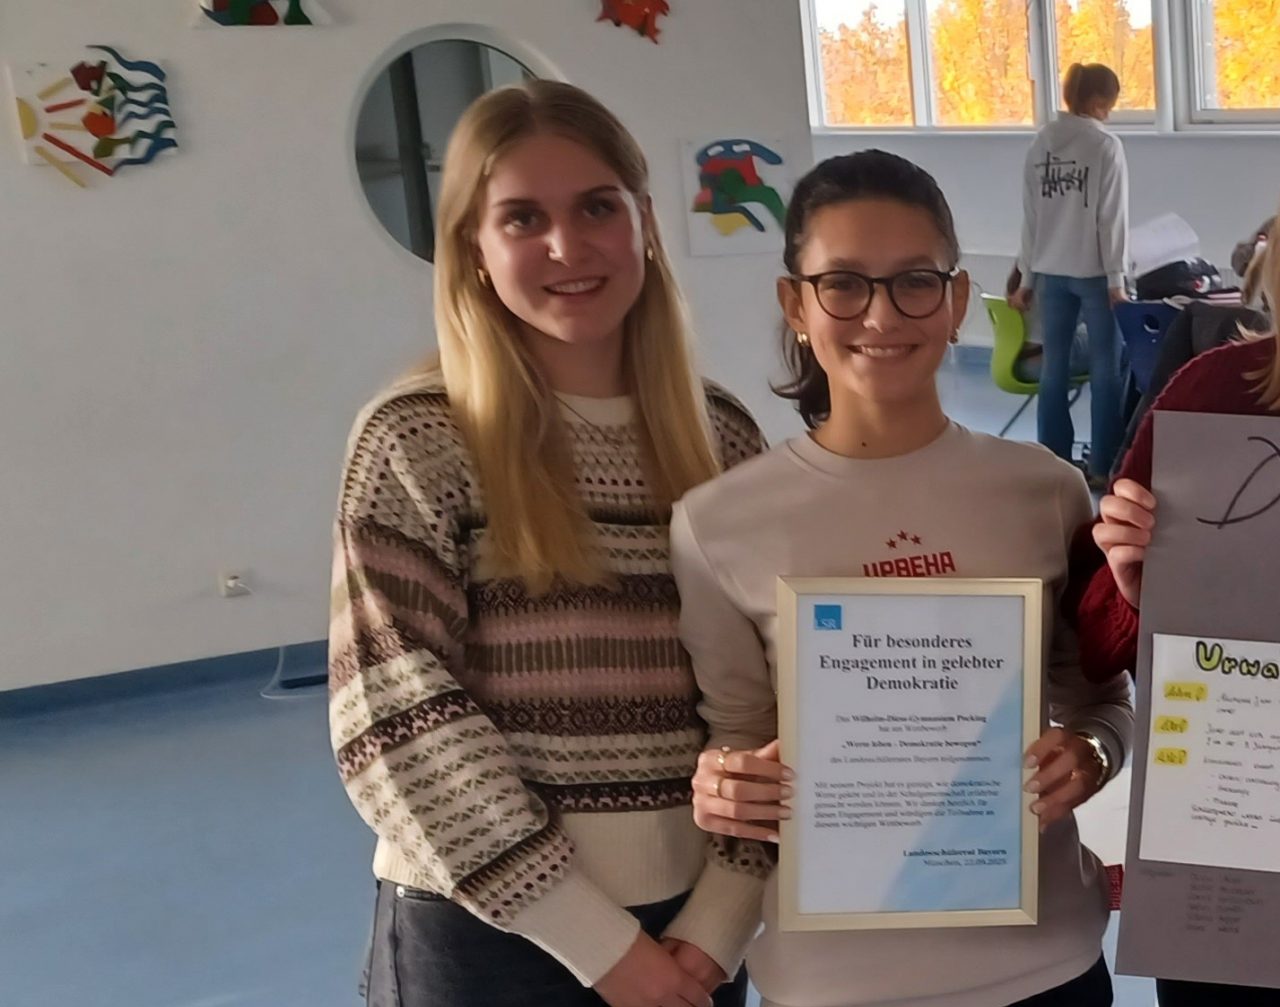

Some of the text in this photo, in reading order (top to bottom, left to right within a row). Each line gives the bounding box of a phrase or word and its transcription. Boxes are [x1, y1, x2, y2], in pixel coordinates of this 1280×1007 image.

[852, 634, 972, 648] Für besonderes
[819, 655, 1004, 672] Engagement in gelebter
[866, 676, 959, 690] Demokratie
